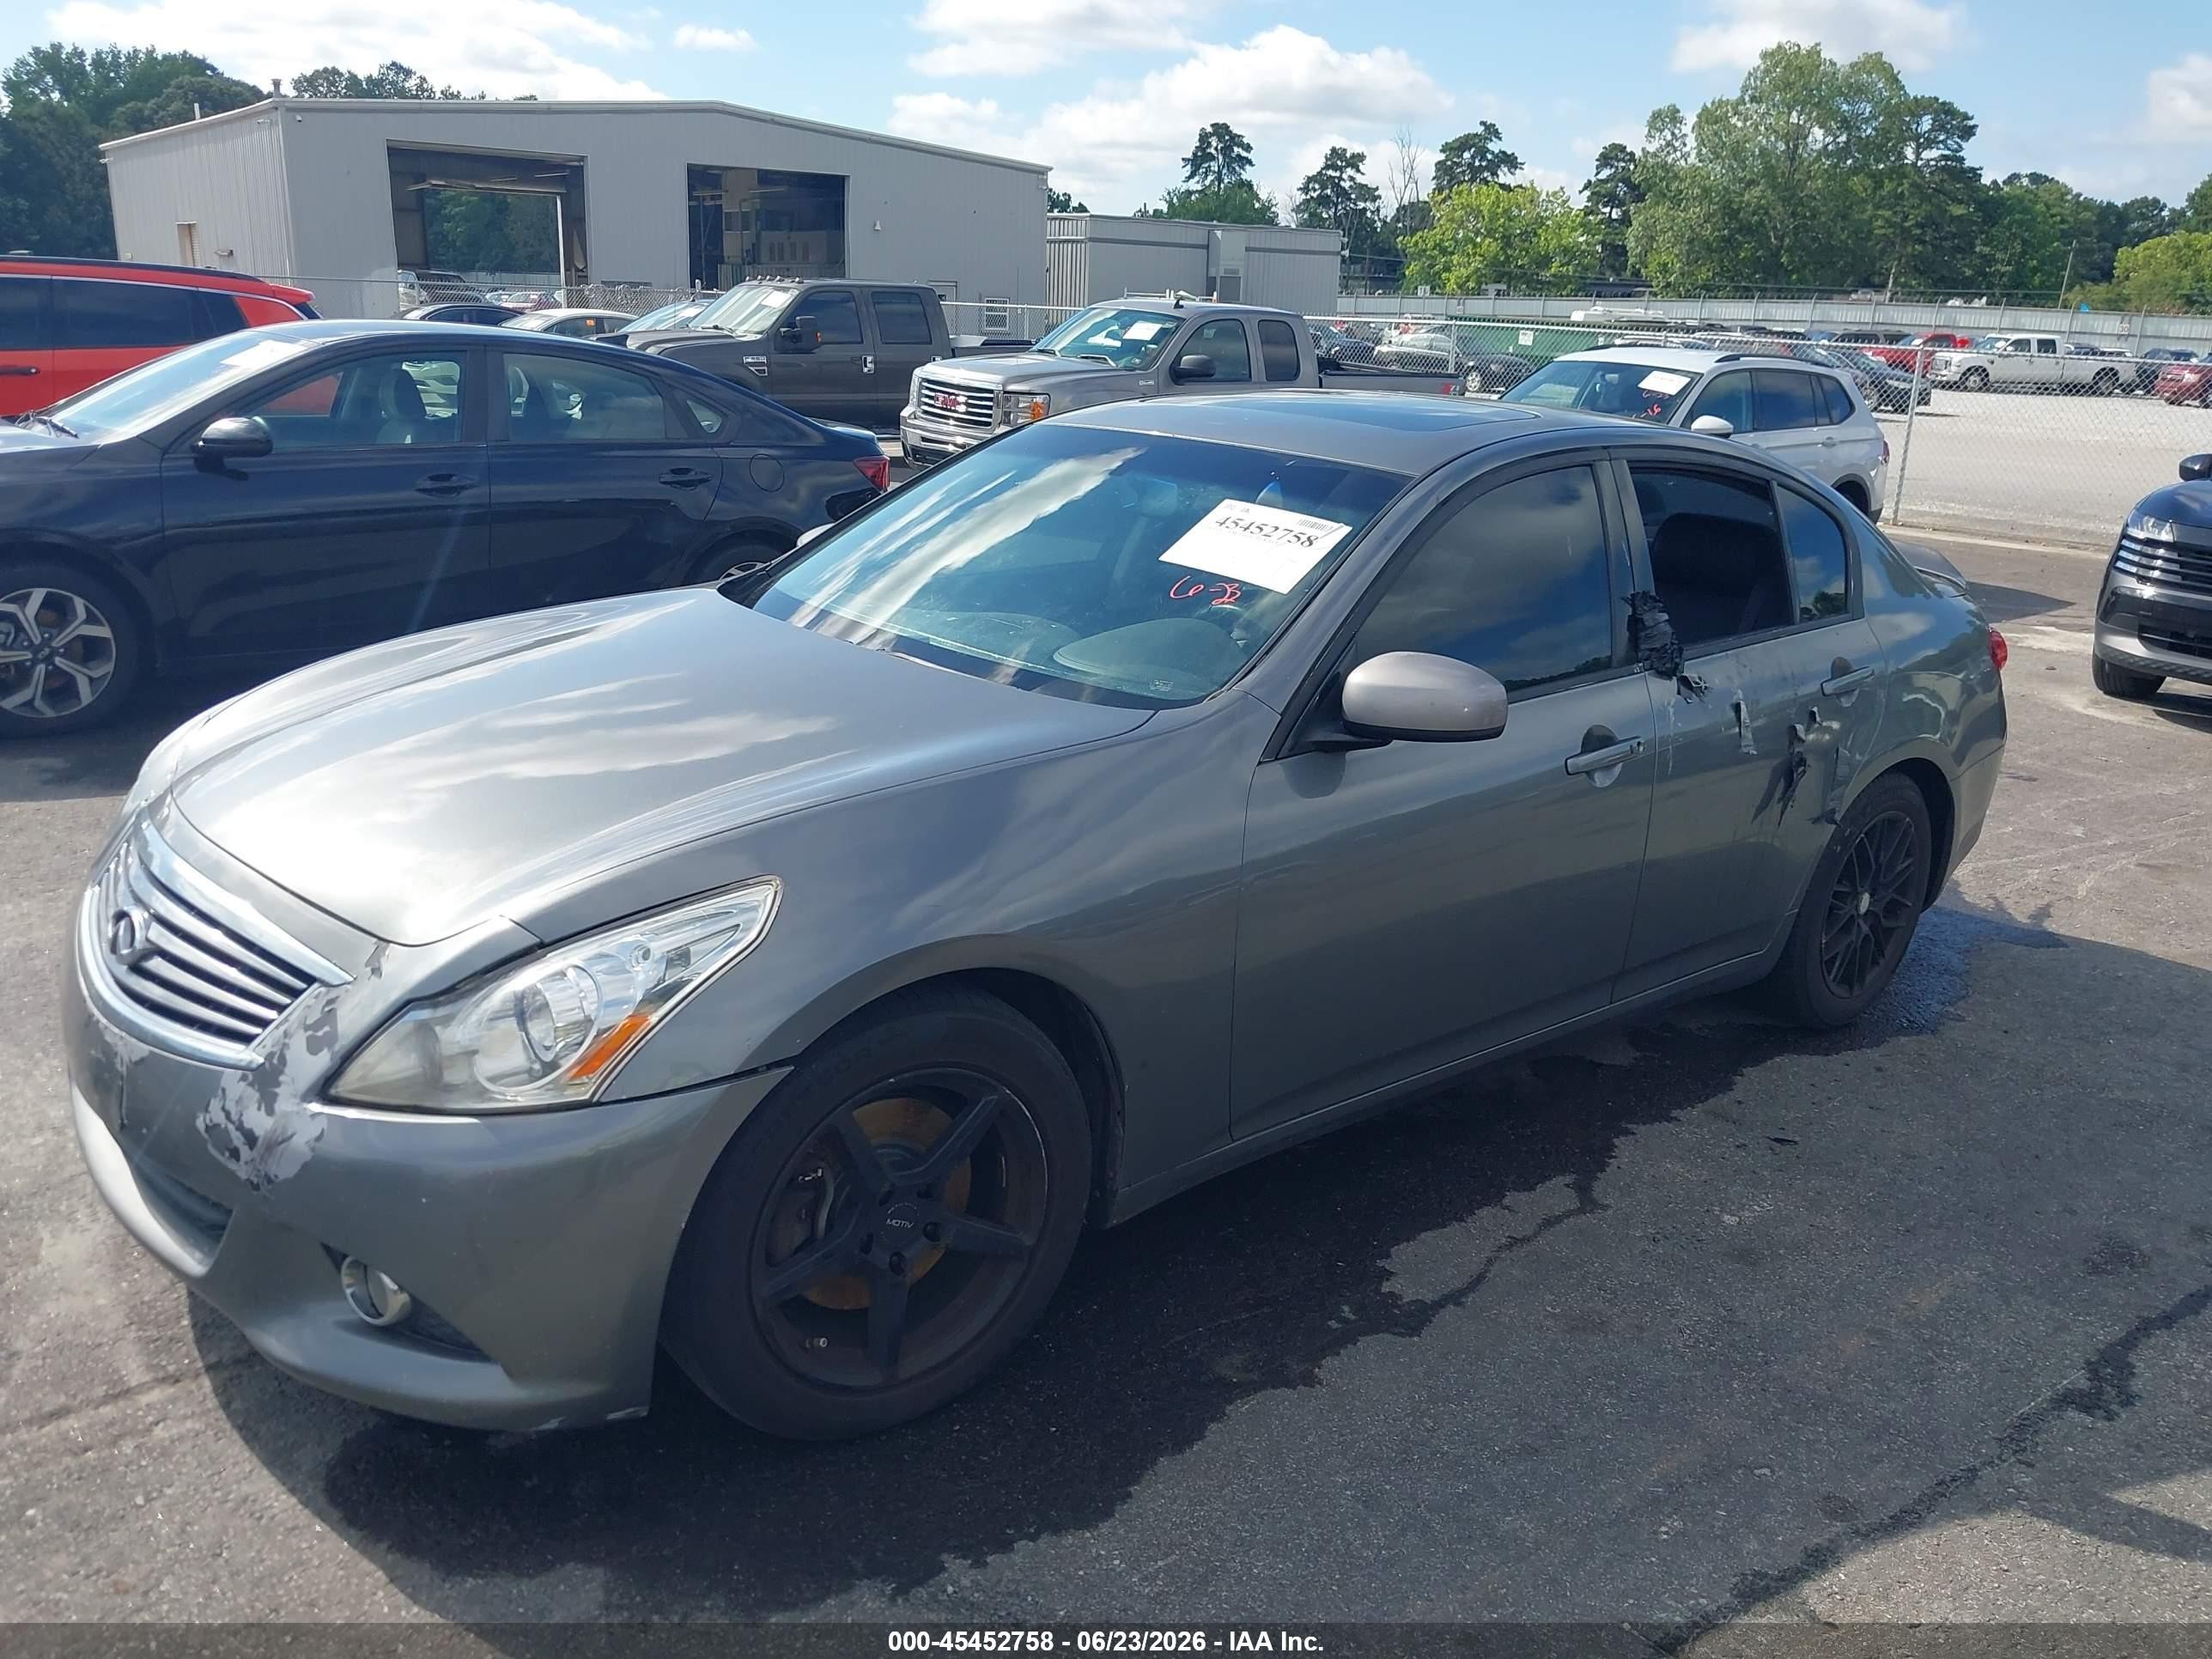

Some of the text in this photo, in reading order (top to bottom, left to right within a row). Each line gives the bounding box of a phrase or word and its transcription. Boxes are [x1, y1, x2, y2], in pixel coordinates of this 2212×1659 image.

[934, 392, 968, 412] GMC
[1216, 516, 1320, 548] 45452758
[885, 1218, 915, 1229] MOTIV
